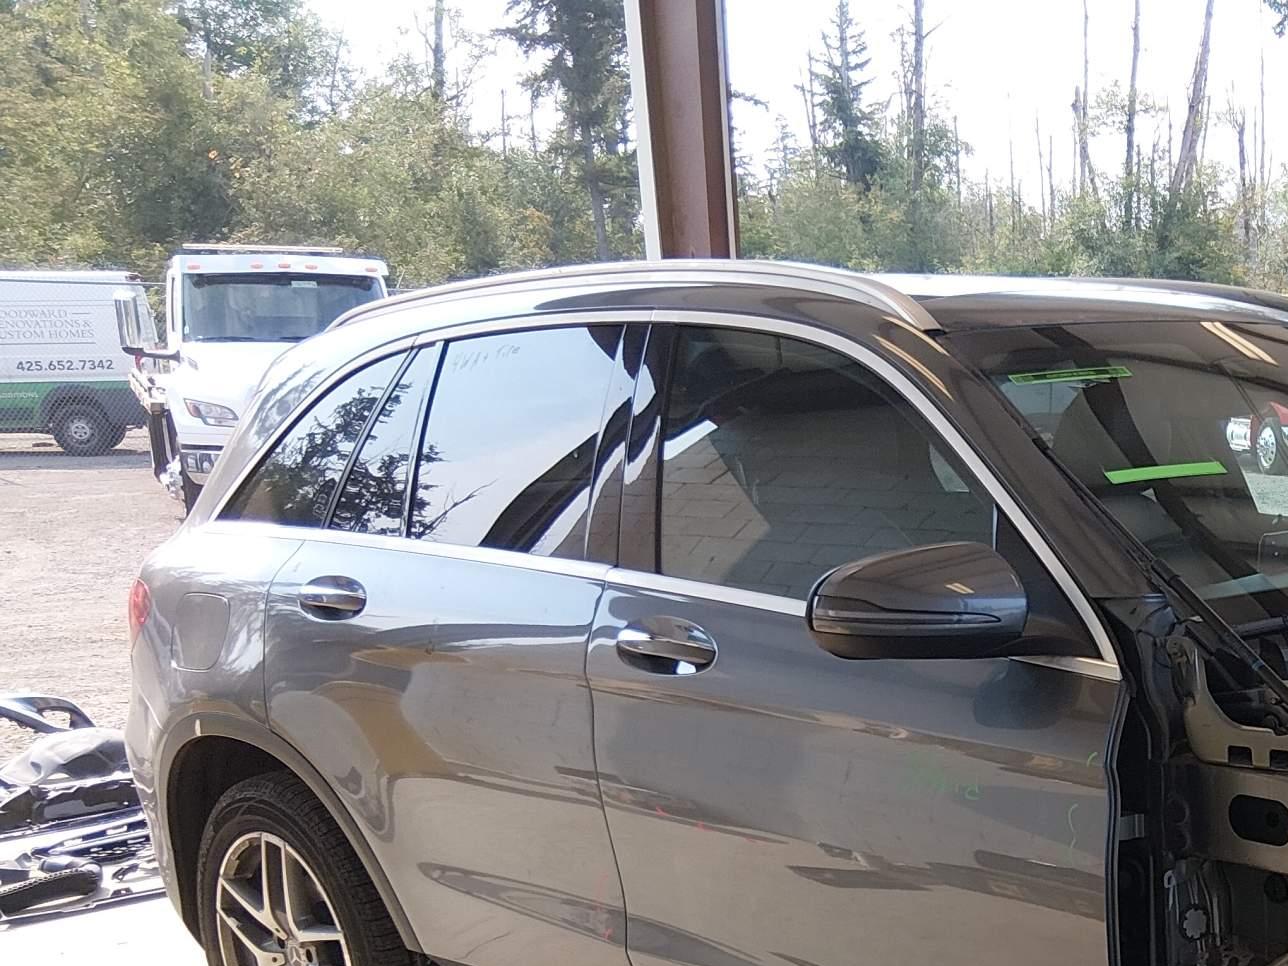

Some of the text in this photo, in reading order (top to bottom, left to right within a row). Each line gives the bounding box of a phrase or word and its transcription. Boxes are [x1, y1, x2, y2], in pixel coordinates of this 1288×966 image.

[82, 320, 92, 328] &
[48, 329, 95, 339] HOMES
[16, 359, 114, 371] 425.652.7342
